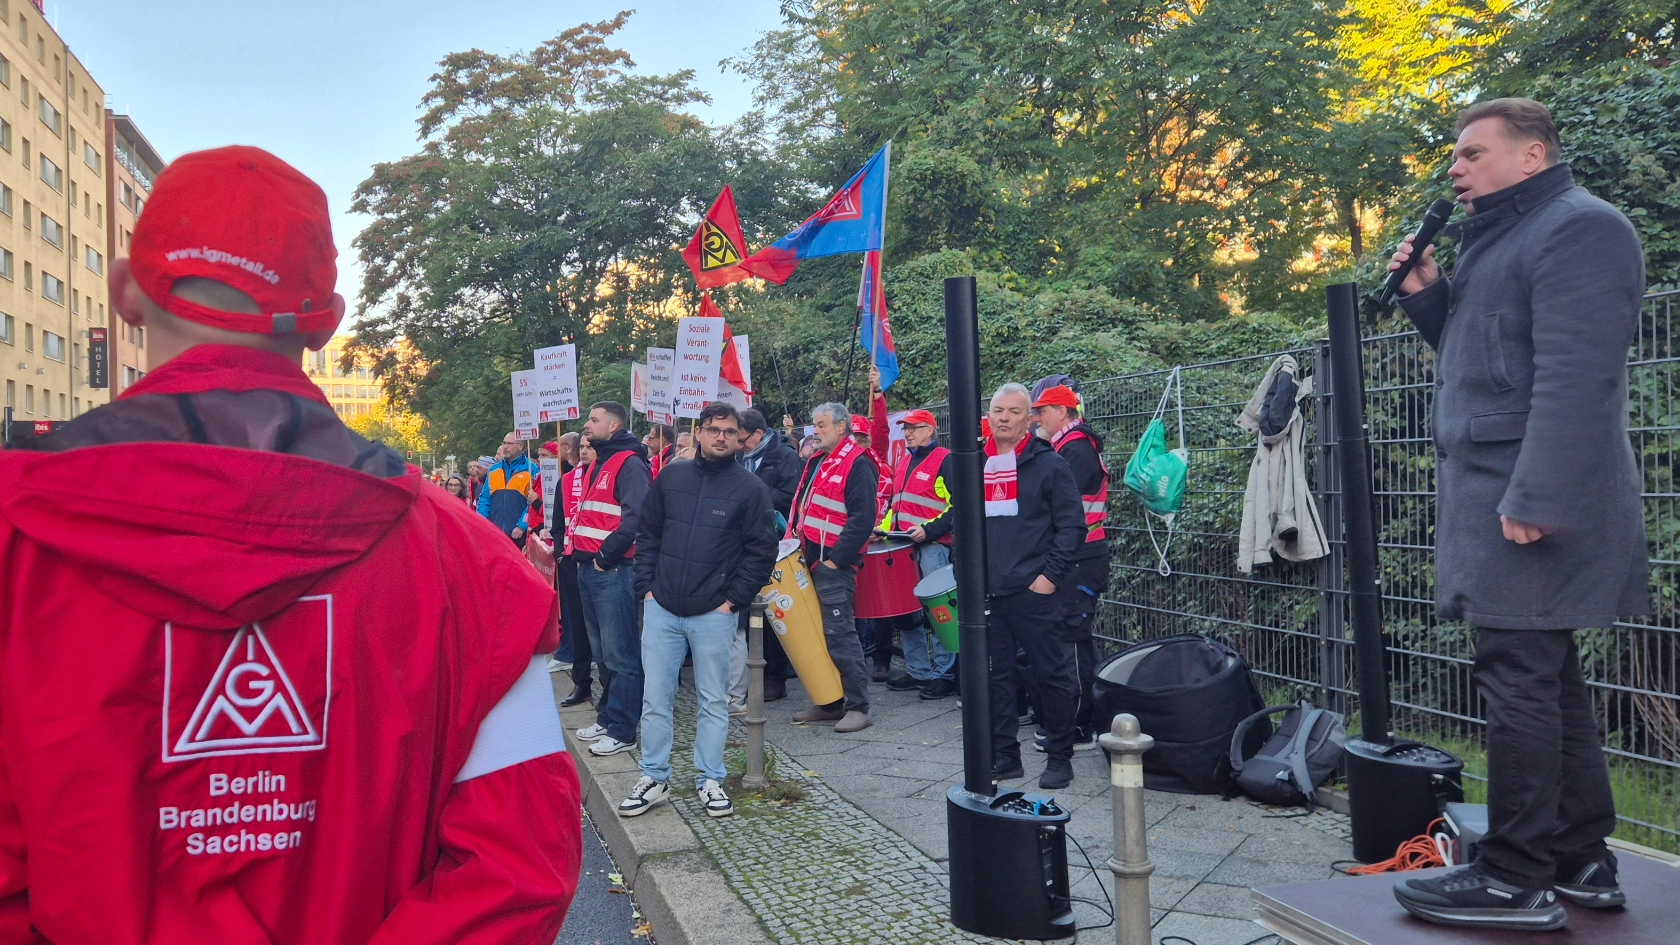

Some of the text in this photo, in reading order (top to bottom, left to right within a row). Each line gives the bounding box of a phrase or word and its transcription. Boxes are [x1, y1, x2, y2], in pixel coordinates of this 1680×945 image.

[165, 246, 280, 285] www.igmetall.de
[689, 324, 710, 333] Soziale
[92, 331, 105, 339] ibis
[686, 338, 709, 347] Verant-
[540, 351, 568, 361] Kaufkraft
[683, 354, 710, 363] wortung
[543, 363, 566, 371] stärken
[681, 373, 707, 382] Ist keine
[519, 379, 528, 388] 5%
[539, 387, 575, 398] Wirtschafts-
[679, 387, 707, 396] Einbahn-
[542, 399, 573, 408] wachstum
[682, 401, 702, 410] straße
[35, 422, 49, 431] ibis
[209, 770, 286, 796] Berlin
[158, 799, 317, 829] Brandenburg
[186, 829, 302, 855] Sachsen
